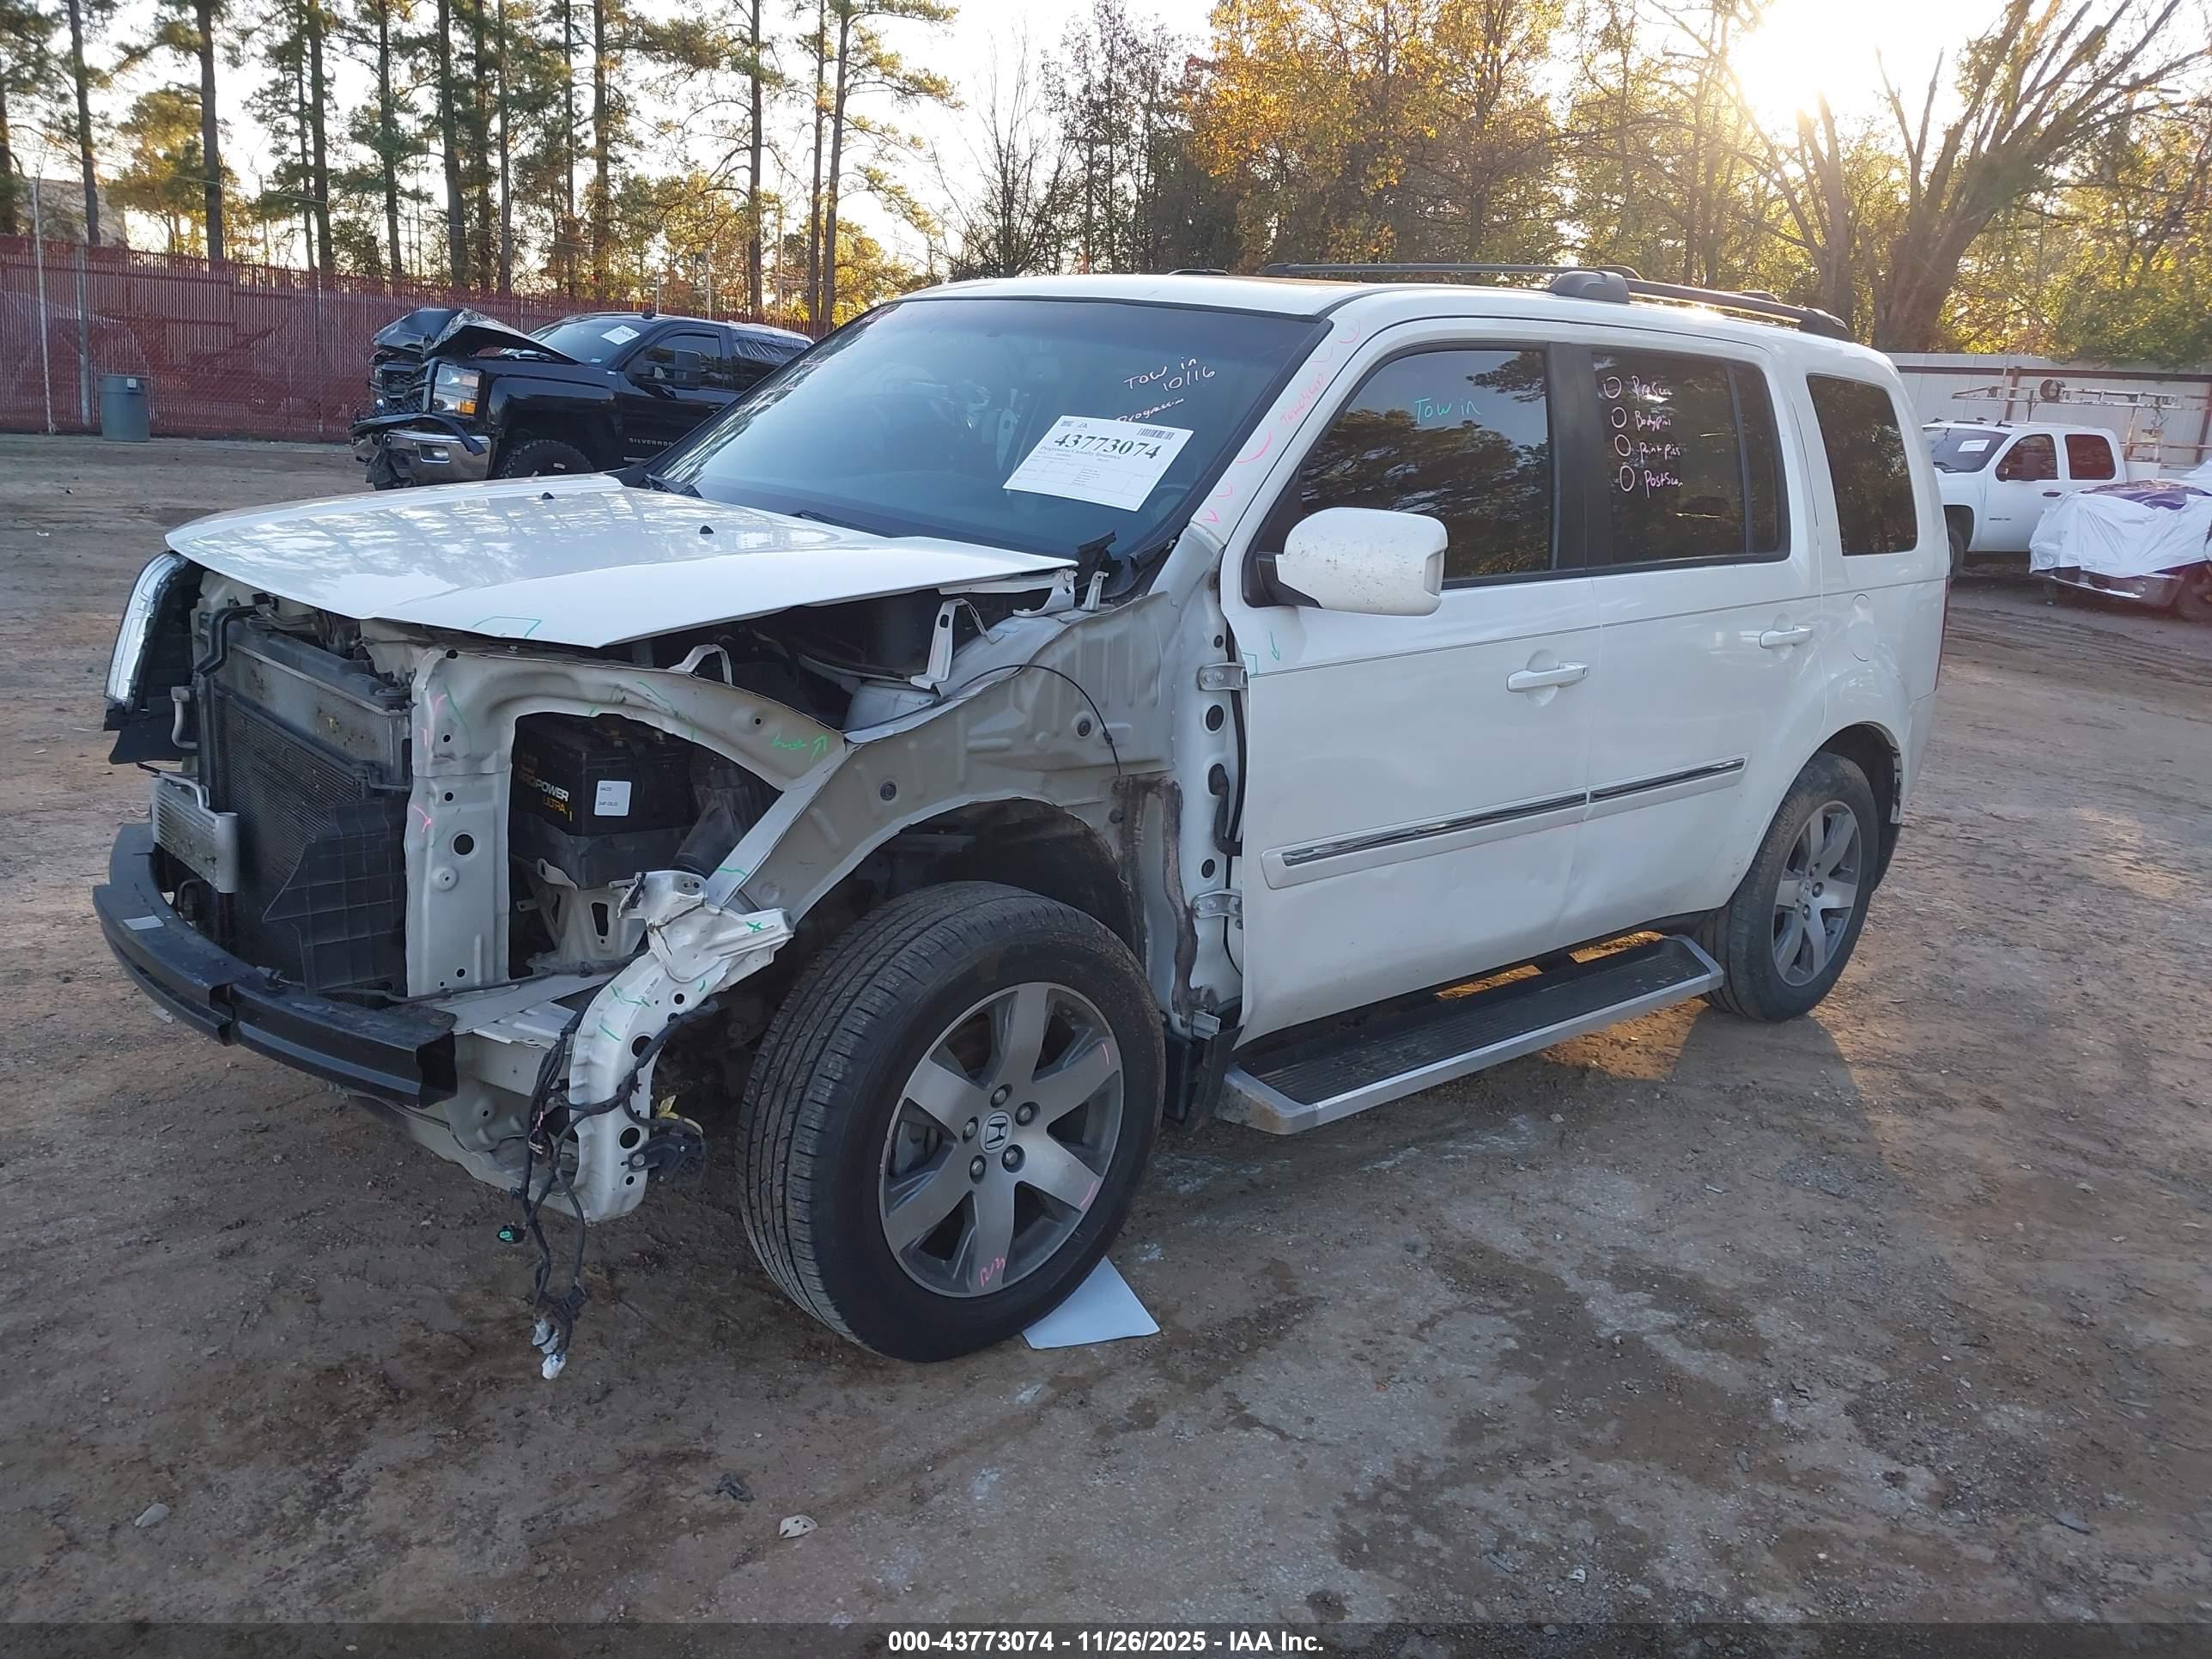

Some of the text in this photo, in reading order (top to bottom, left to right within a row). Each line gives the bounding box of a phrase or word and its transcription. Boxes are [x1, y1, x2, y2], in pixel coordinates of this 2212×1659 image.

[1180, 356, 1197, 370] in
[1460, 398, 1482, 417] in
[628, 437, 673, 447] SILVERADO
[1054, 434, 1162, 459] 43773074
